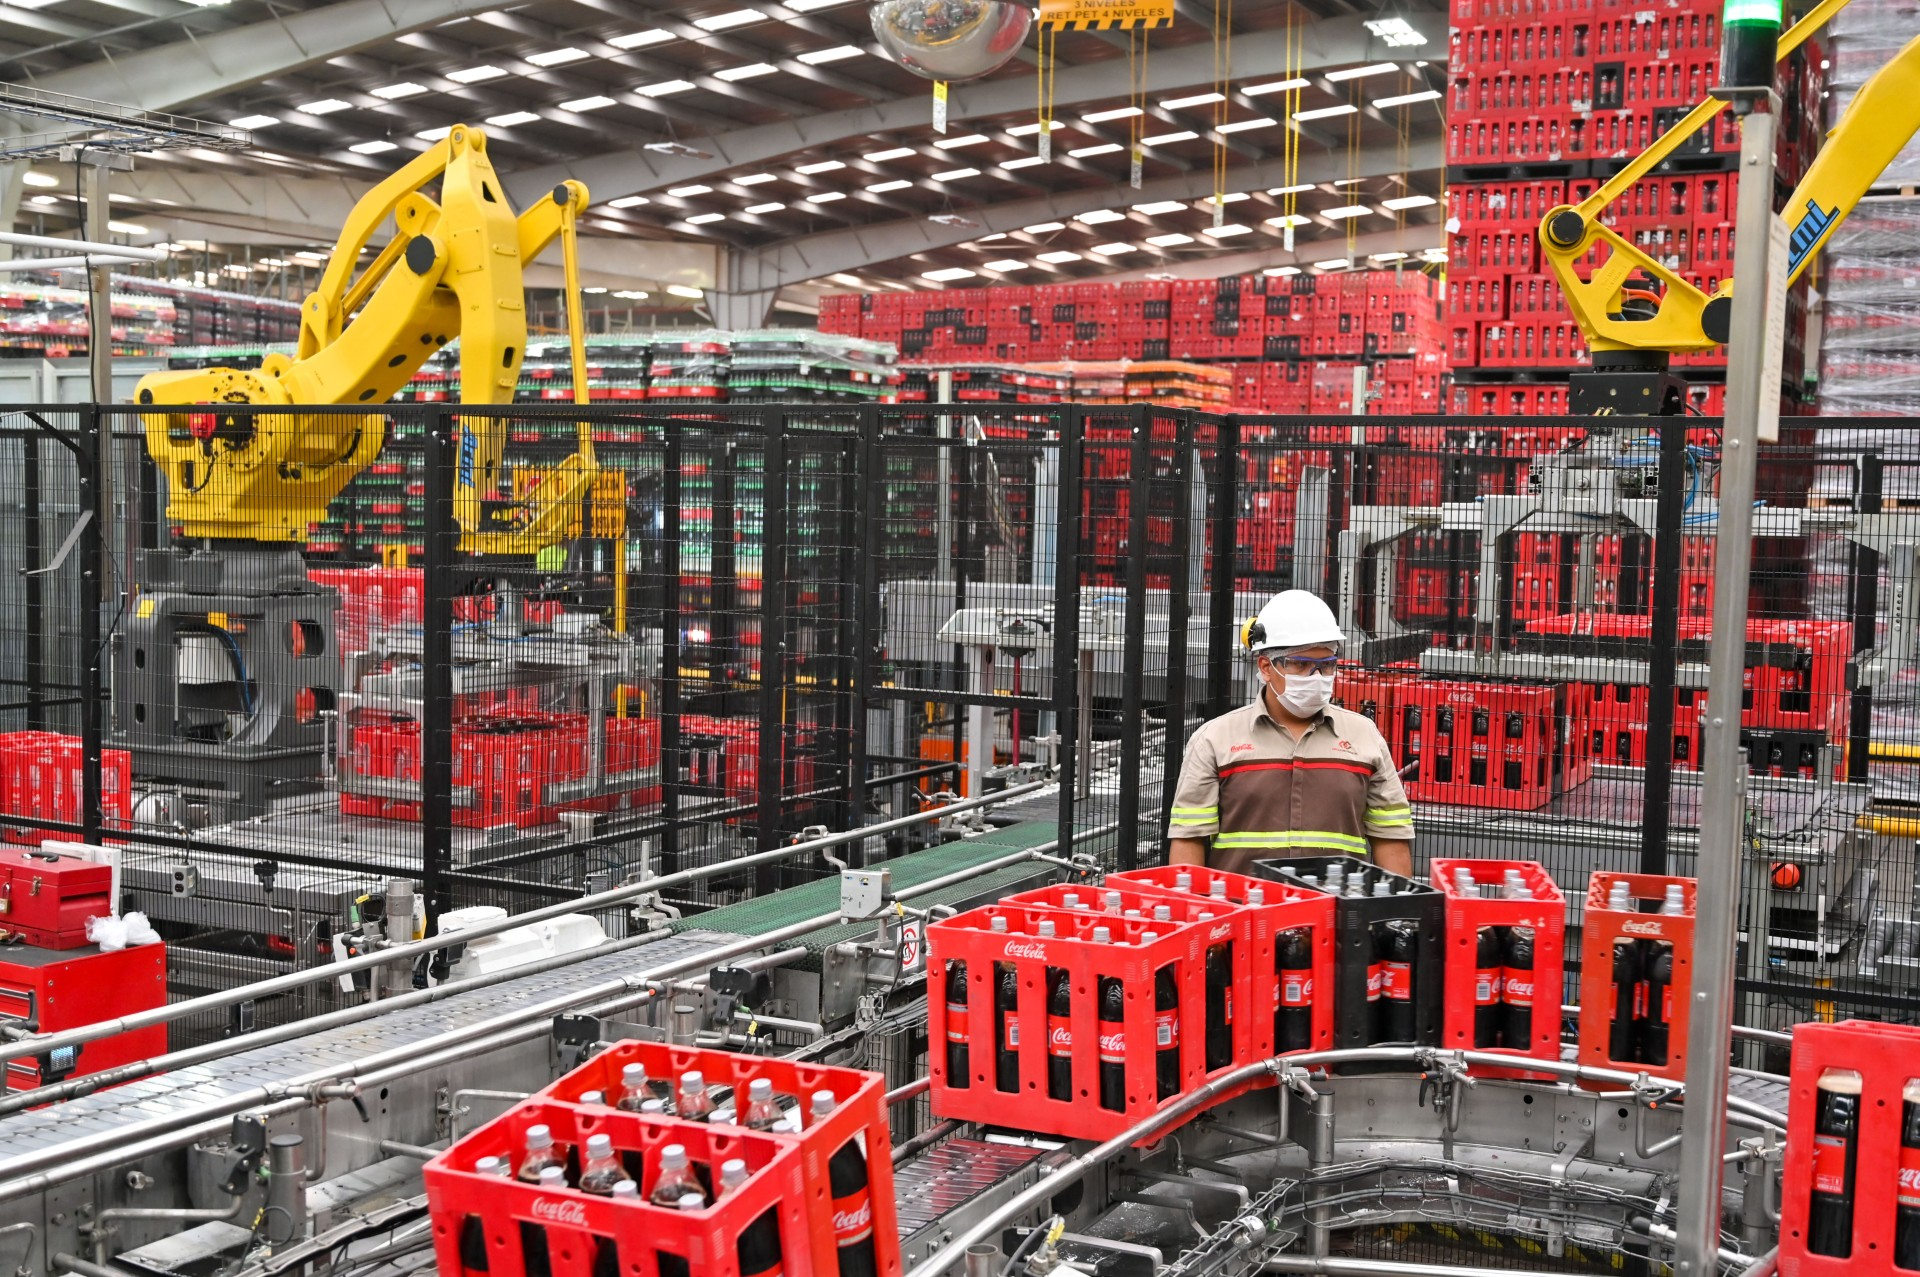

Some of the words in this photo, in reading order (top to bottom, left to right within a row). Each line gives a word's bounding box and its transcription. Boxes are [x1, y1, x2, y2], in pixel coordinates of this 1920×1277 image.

[1084, 0, 1136, 8] NIVELES
[1047, 11, 1071, 20] RET
[1075, 11, 1098, 19] PET
[1102, 10, 1109, 18] 4
[1113, 8, 1165, 18] NIVELES
